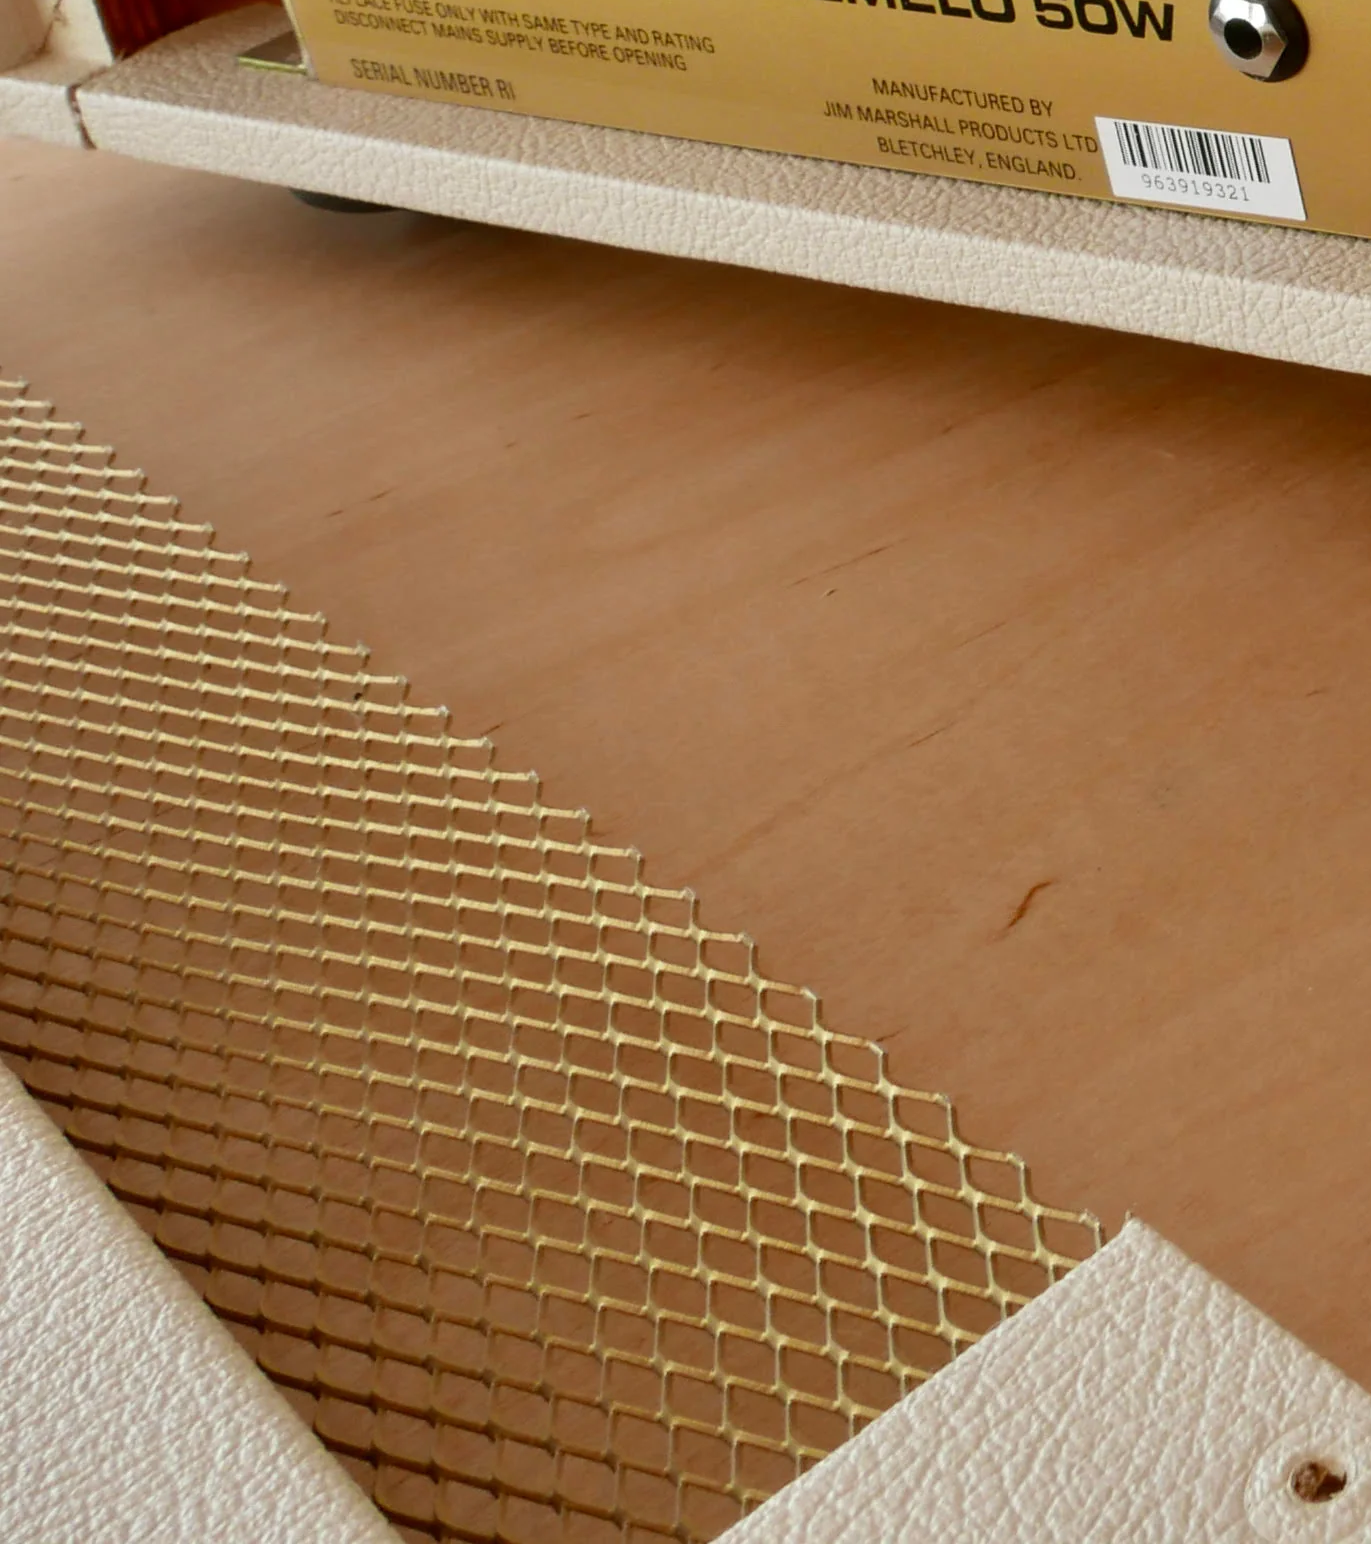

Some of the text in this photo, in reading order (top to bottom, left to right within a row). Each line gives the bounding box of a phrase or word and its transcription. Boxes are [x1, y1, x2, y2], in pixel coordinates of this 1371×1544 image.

[334, 9, 688, 72] DISCONNECT MAINS SUPPLY BEFORE OPENING
[435, 2, 476, 22] ONLY
[479, 7, 521, 29] WITH
[523, 13, 568, 36] SAME
[570, 19, 612, 41] TYPE
[615, 25, 651, 46] AND
[653, 30, 716, 54] RATING
[350, 57, 411, 86] SERIAL
[414, 66, 493, 98] NUMBER
[872, 77, 1054, 119] MANUFACTURED BY
[823, 100, 1099, 154] JIM MARSHALL PRODUCTS LTD
[877, 136, 1083, 183] BLETCHLEY, ENGLAND.
[1141, 172, 1250, 204] 963919321
